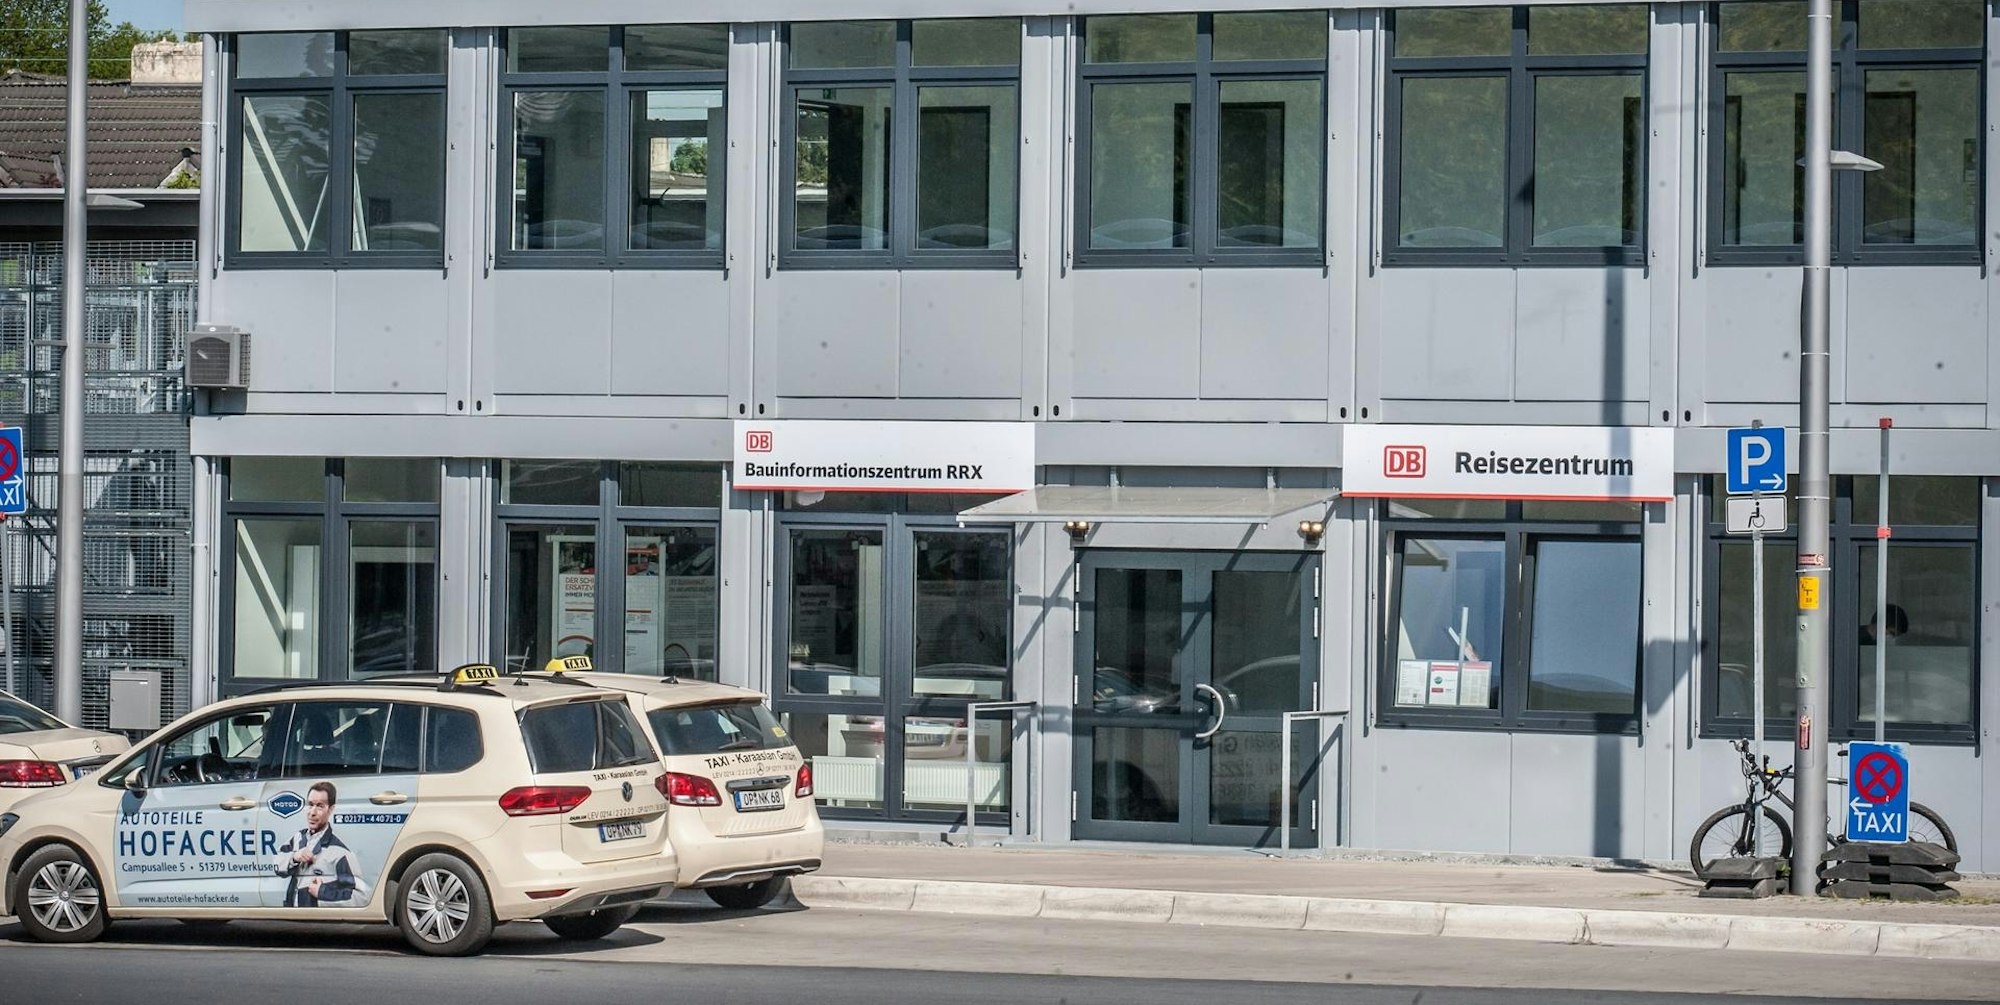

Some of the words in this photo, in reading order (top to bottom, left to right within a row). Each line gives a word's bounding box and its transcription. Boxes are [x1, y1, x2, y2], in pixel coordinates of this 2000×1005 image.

[748, 433, 771, 450] DB
[1387, 448, 1423, 475] DB
[1455, 451, 1634, 476] Reisezentrum
[1741, 436, 1772, 485] P
[745, 462, 942, 479] Bauinformationszentrum
[946, 465, 983, 480] RRX
[565, 658, 588, 669] TAXI
[468, 668, 493, 679] TAXI
[704, 755, 730, 769] TAXI
[593, 773, 607, 782] TAXI
[758, 791, 770, 804] NK
[770, 790, 781, 803] 68
[120, 811, 203, 825] AUTOTEILE
[344, 815, 366, 823] 02171
[1854, 812, 1901, 833] TAXI
[120, 830, 278, 856] HOFACKER
[122, 862, 177, 874] Campusallee
[179, 862, 185, 872] 5
[199, 862, 226, 872] 51379
[227, 861, 279, 872] Leverkusen
[138, 895, 240, 903] www.autoteile-hofacker.de
